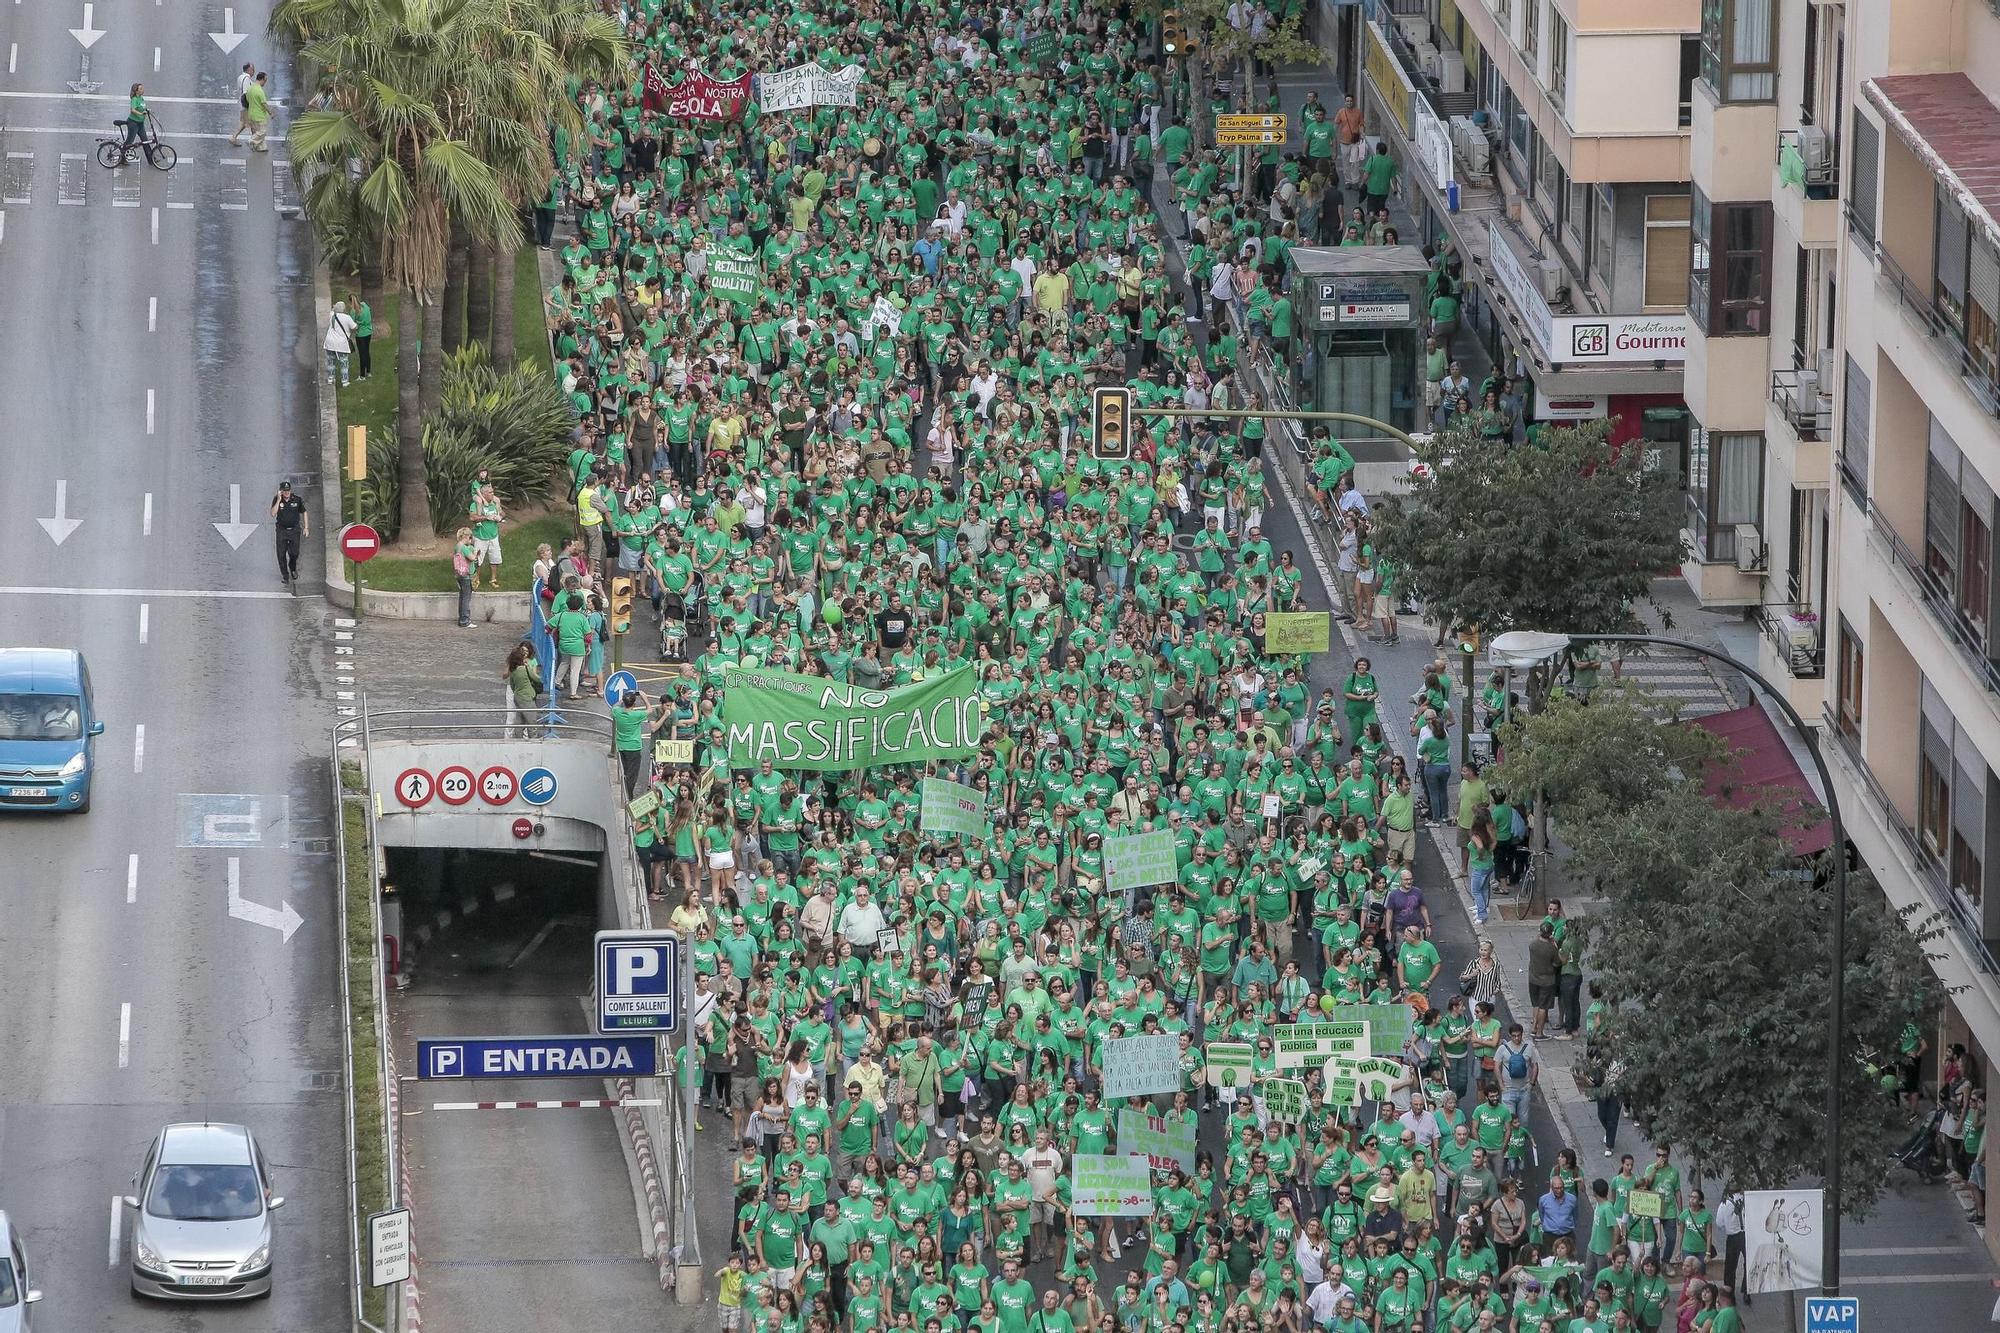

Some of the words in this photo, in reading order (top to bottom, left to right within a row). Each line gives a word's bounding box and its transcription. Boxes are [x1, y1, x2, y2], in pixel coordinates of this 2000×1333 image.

[704, 88, 745, 99] NOSTRA
[1323, 286, 1333, 299] P
[819, 685, 890, 709] NO
[445, 779, 467, 792] 20
[616, 948, 659, 995] P
[608, 1002, 633, 1012] COMTE
[636, 1001, 666, 1011] SALLENT
[623, 1016, 653, 1025] LLIURE
[1275, 1028, 1293, 1037] Per
[1294, 1028, 1313, 1036] una
[1315, 1025, 1364, 1035] educació
[1281, 1041, 1317, 1052] pública
[1339, 1041, 1352, 1049] de
[438, 1051, 456, 1073] P
[483, 1046, 634, 1073] ENTRADA
[1285, 1083, 1304, 1095] TIL
[1266, 1091, 1285, 1102] per
[1290, 1095, 1299, 1104] la
[1147, 1115, 1166, 1134] TIL
[1810, 1305, 1855, 1322] VAP
